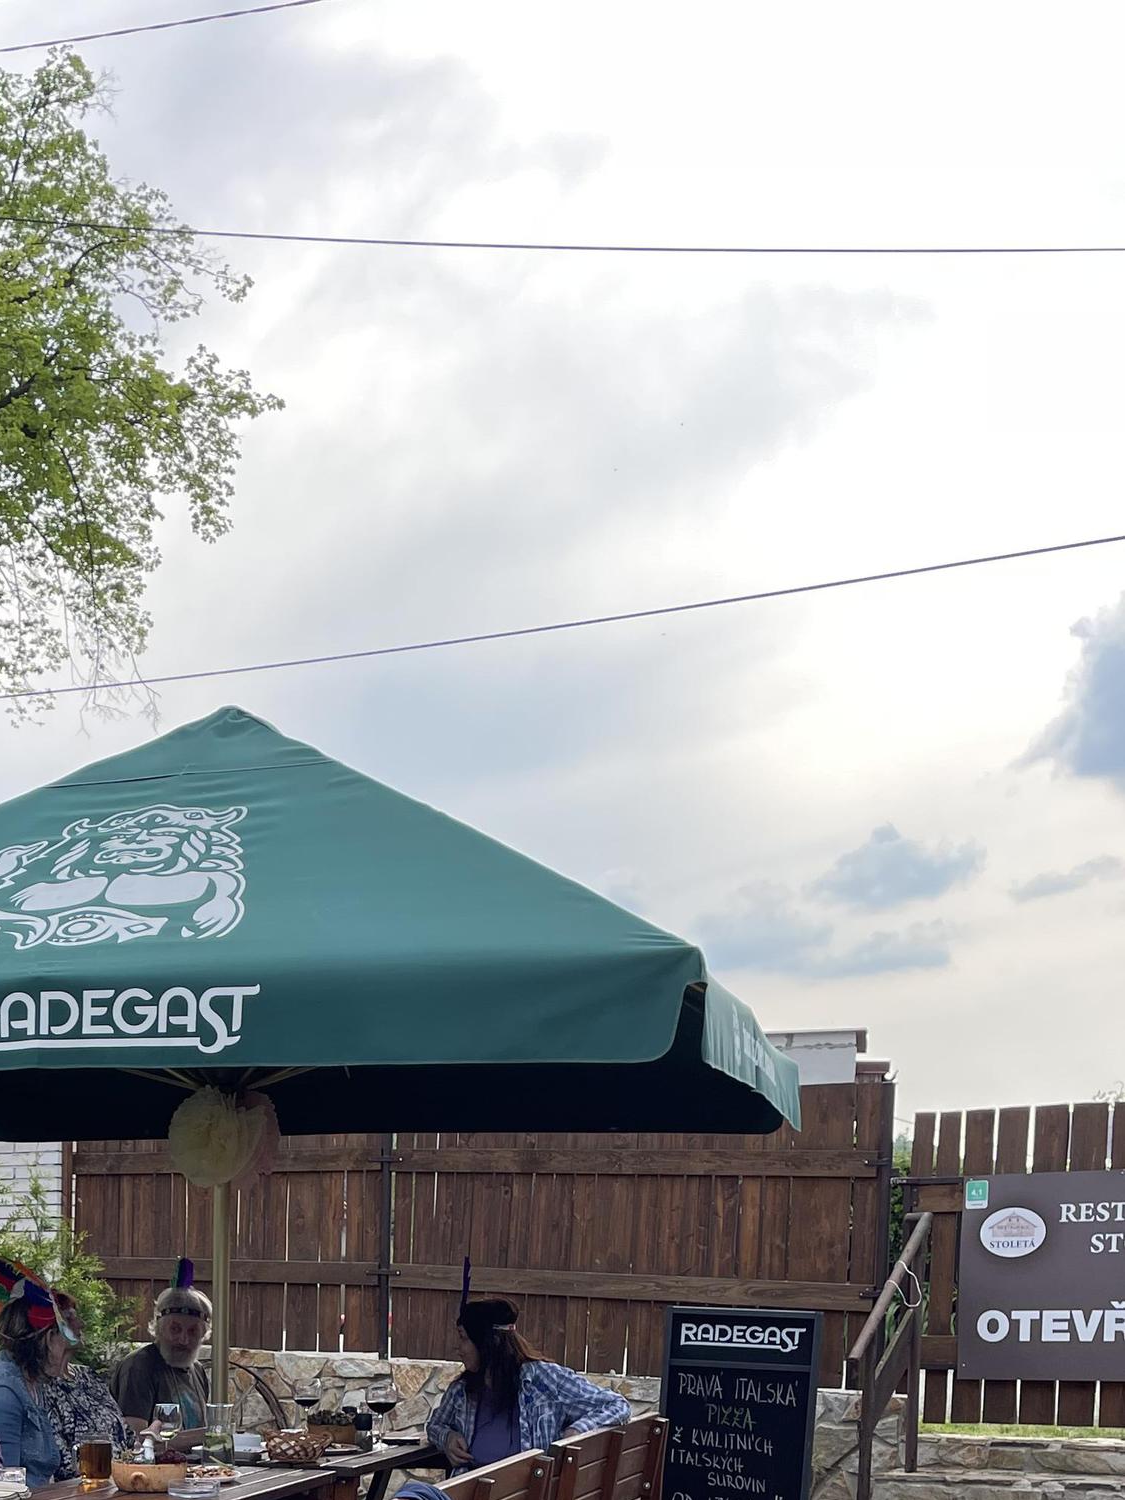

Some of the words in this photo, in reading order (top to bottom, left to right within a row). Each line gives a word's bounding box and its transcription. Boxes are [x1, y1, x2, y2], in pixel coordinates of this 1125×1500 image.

[1059, 1203, 1125, 1223] REST
[989, 1238, 1036, 1249] STOLETÁ
[1091, 1233, 1125, 1254] ST
[976, 1300, 1125, 1343] OTEVŘ
[680, 1323, 806, 1353] RADEGAST
[678, 1371, 723, 1399] PRAVÁ
[735, 1377, 799, 1407] ITALSKÁ
[706, 1403, 757, 1432] PIZZA
[691, 1428, 774, 1457] KVALITNÍCH
[670, 1448, 745, 1473] ITALSKÝCH
[707, 1471, 766, 1494] SUROVIN
